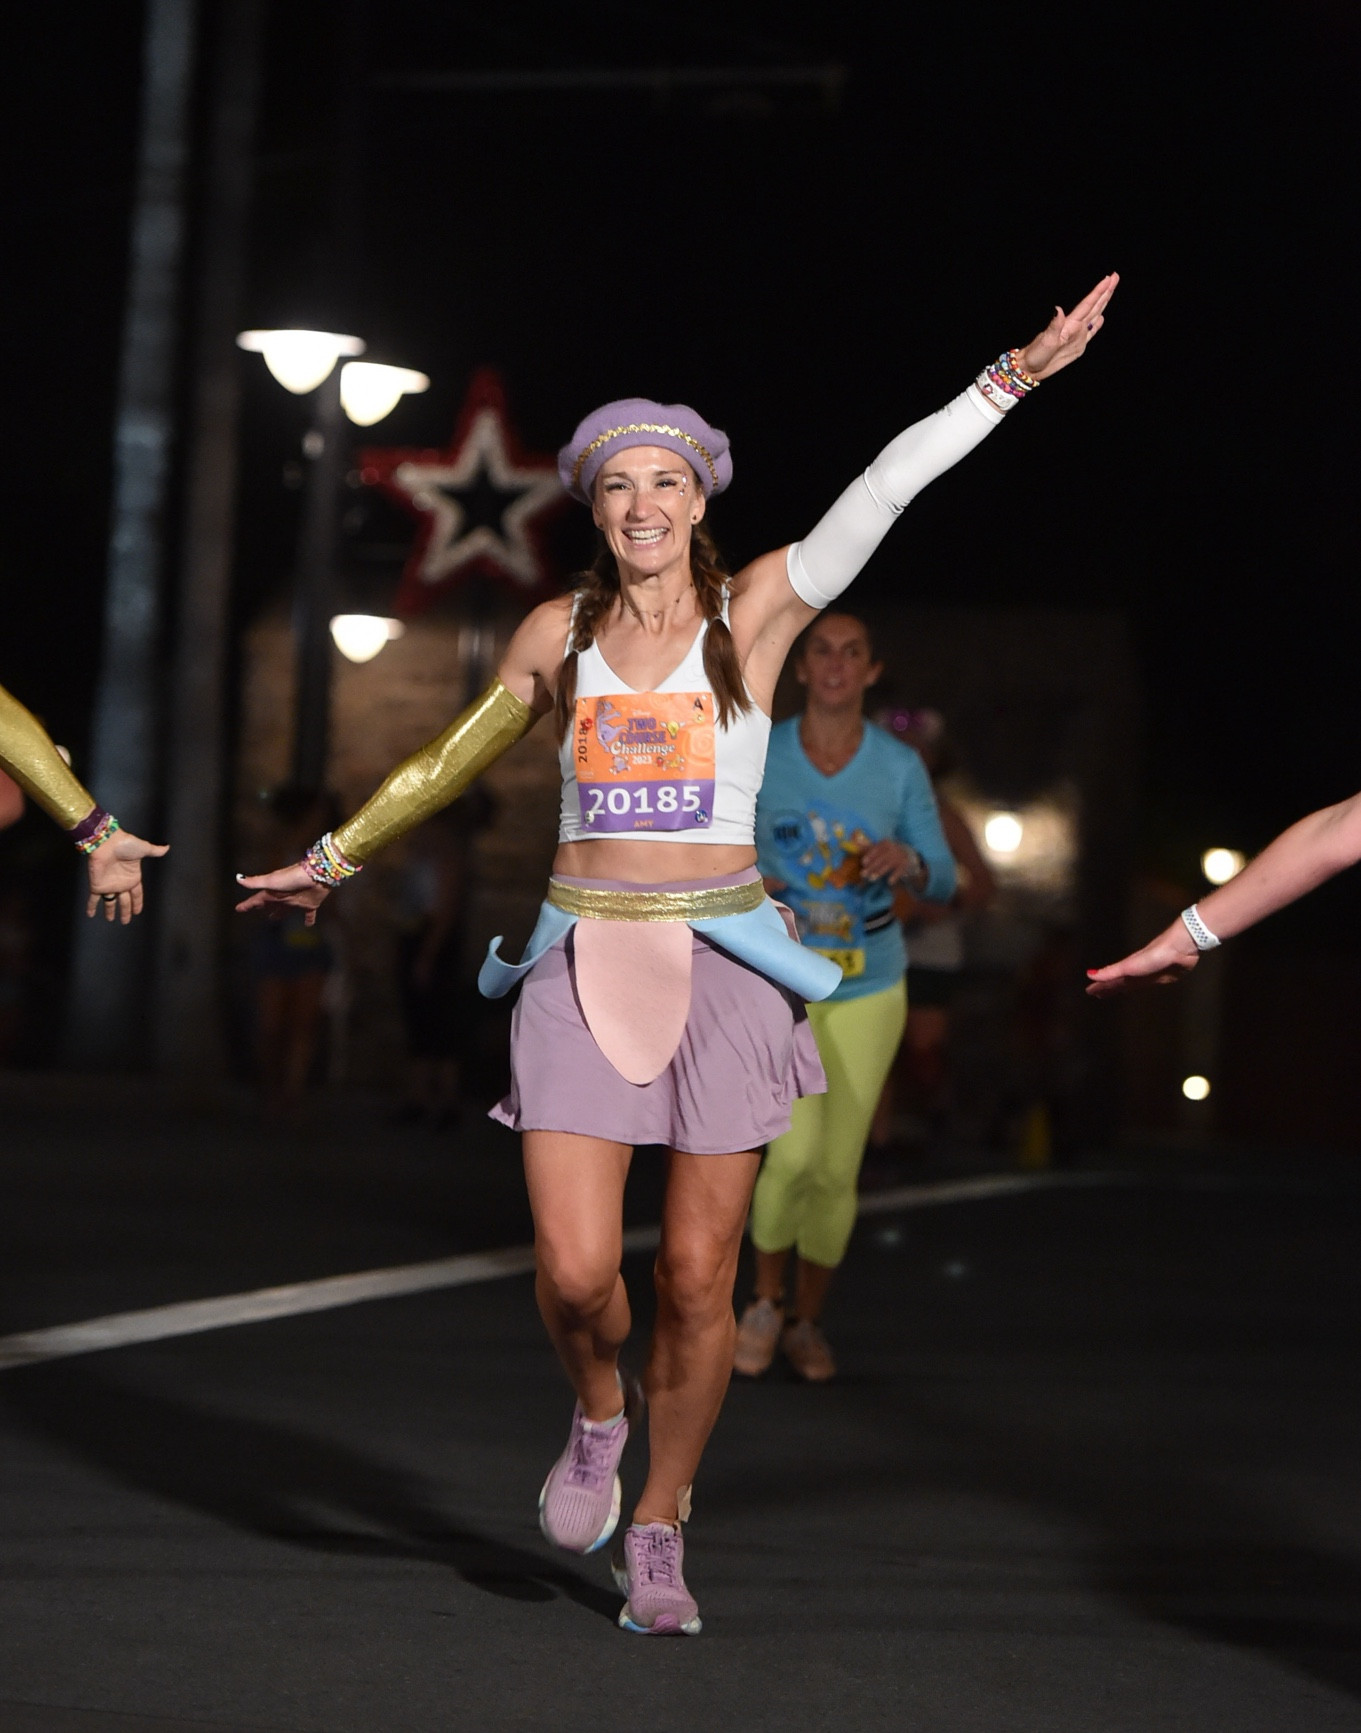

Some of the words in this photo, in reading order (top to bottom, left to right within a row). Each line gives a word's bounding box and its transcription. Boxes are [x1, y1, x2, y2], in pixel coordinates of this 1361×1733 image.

[694, 697, 704, 711] A
[627, 718, 657, 730] TWO
[619, 731, 666, 743] COURSE
[610, 742, 675, 755] Challenge
[588, 785, 701, 815] 20185
